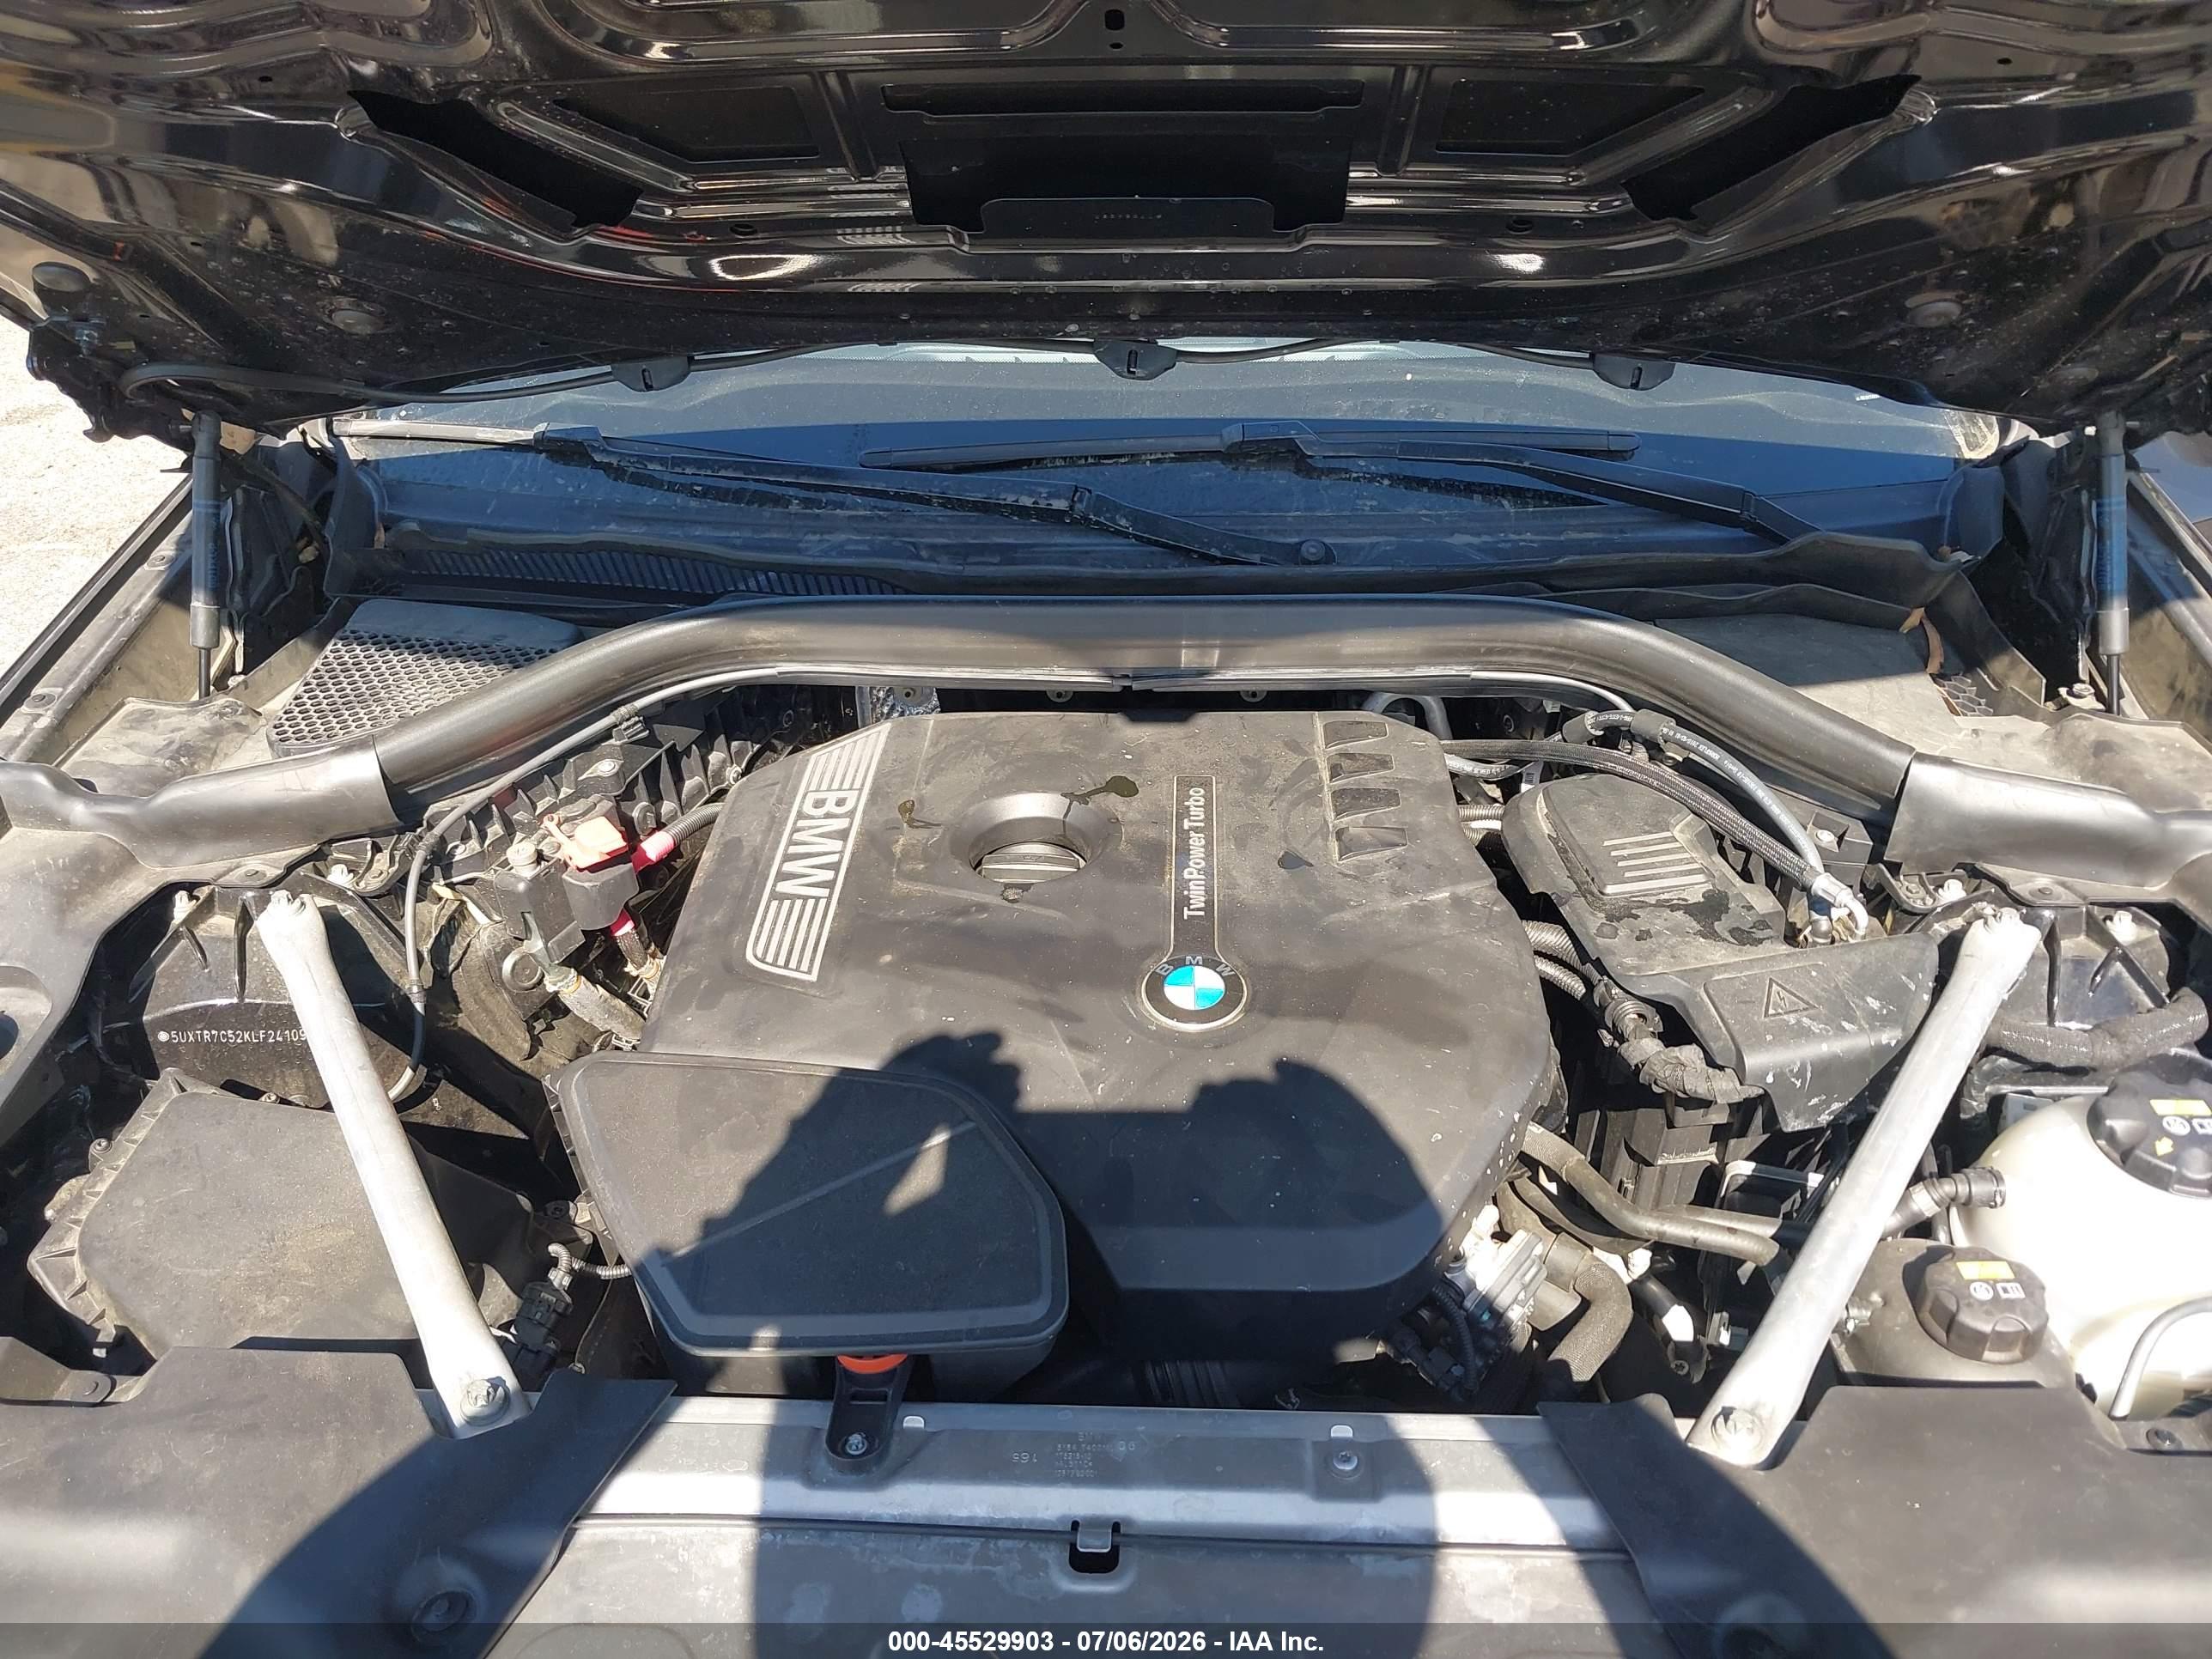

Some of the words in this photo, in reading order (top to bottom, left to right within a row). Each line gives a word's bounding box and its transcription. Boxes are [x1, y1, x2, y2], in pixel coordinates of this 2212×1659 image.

[1183, 787, 1206, 830] Turbo
[775, 790, 860, 897] BMW
[1183, 830, 1206, 921] TwinPower
[1156, 955, 1236, 976] BMW
